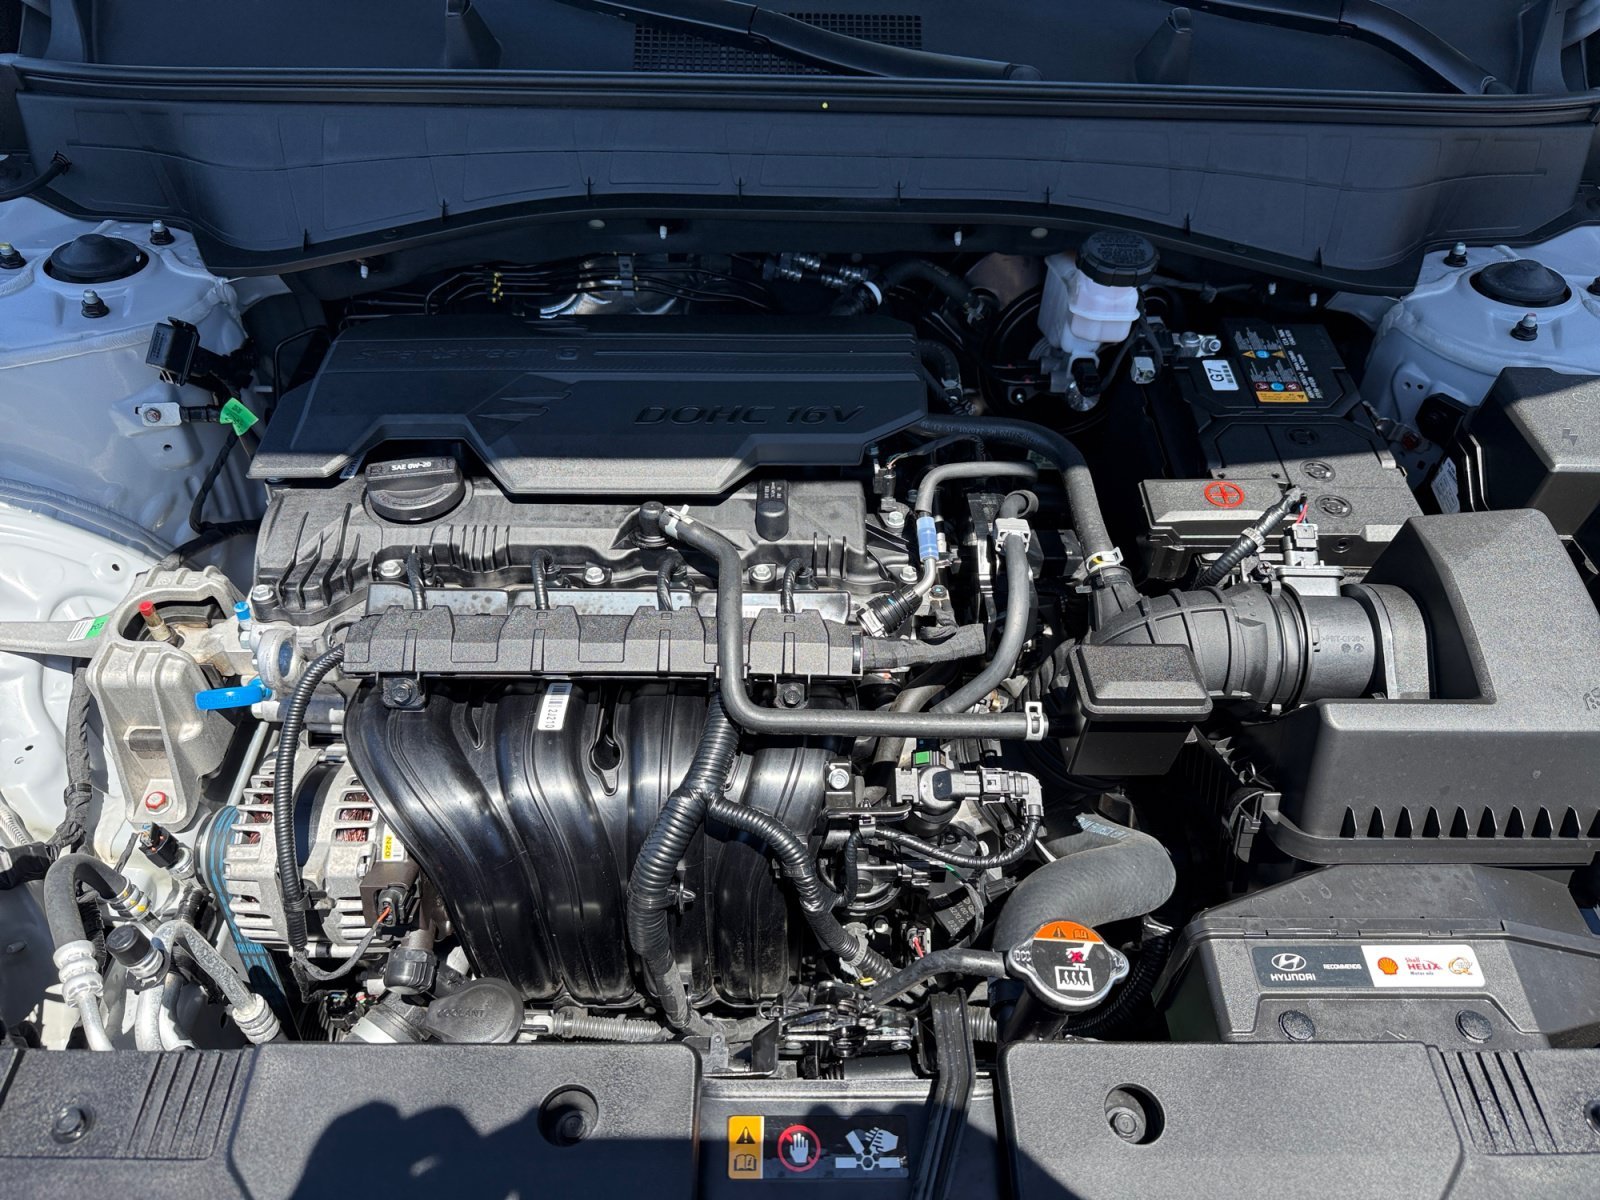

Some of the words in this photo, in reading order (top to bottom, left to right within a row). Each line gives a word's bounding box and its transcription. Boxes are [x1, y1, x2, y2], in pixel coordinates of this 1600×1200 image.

[1206, 366, 1225, 383] G7
[634, 405, 775, 425] DOHC
[786, 405, 864, 425] 16V
[407, 461, 432, 470] 0W-20
[1407, 963, 1441, 971] HELIX
[1270, 973, 1317, 982] HYUNDAI
[437, 1008, 486, 1018] COOLANT
